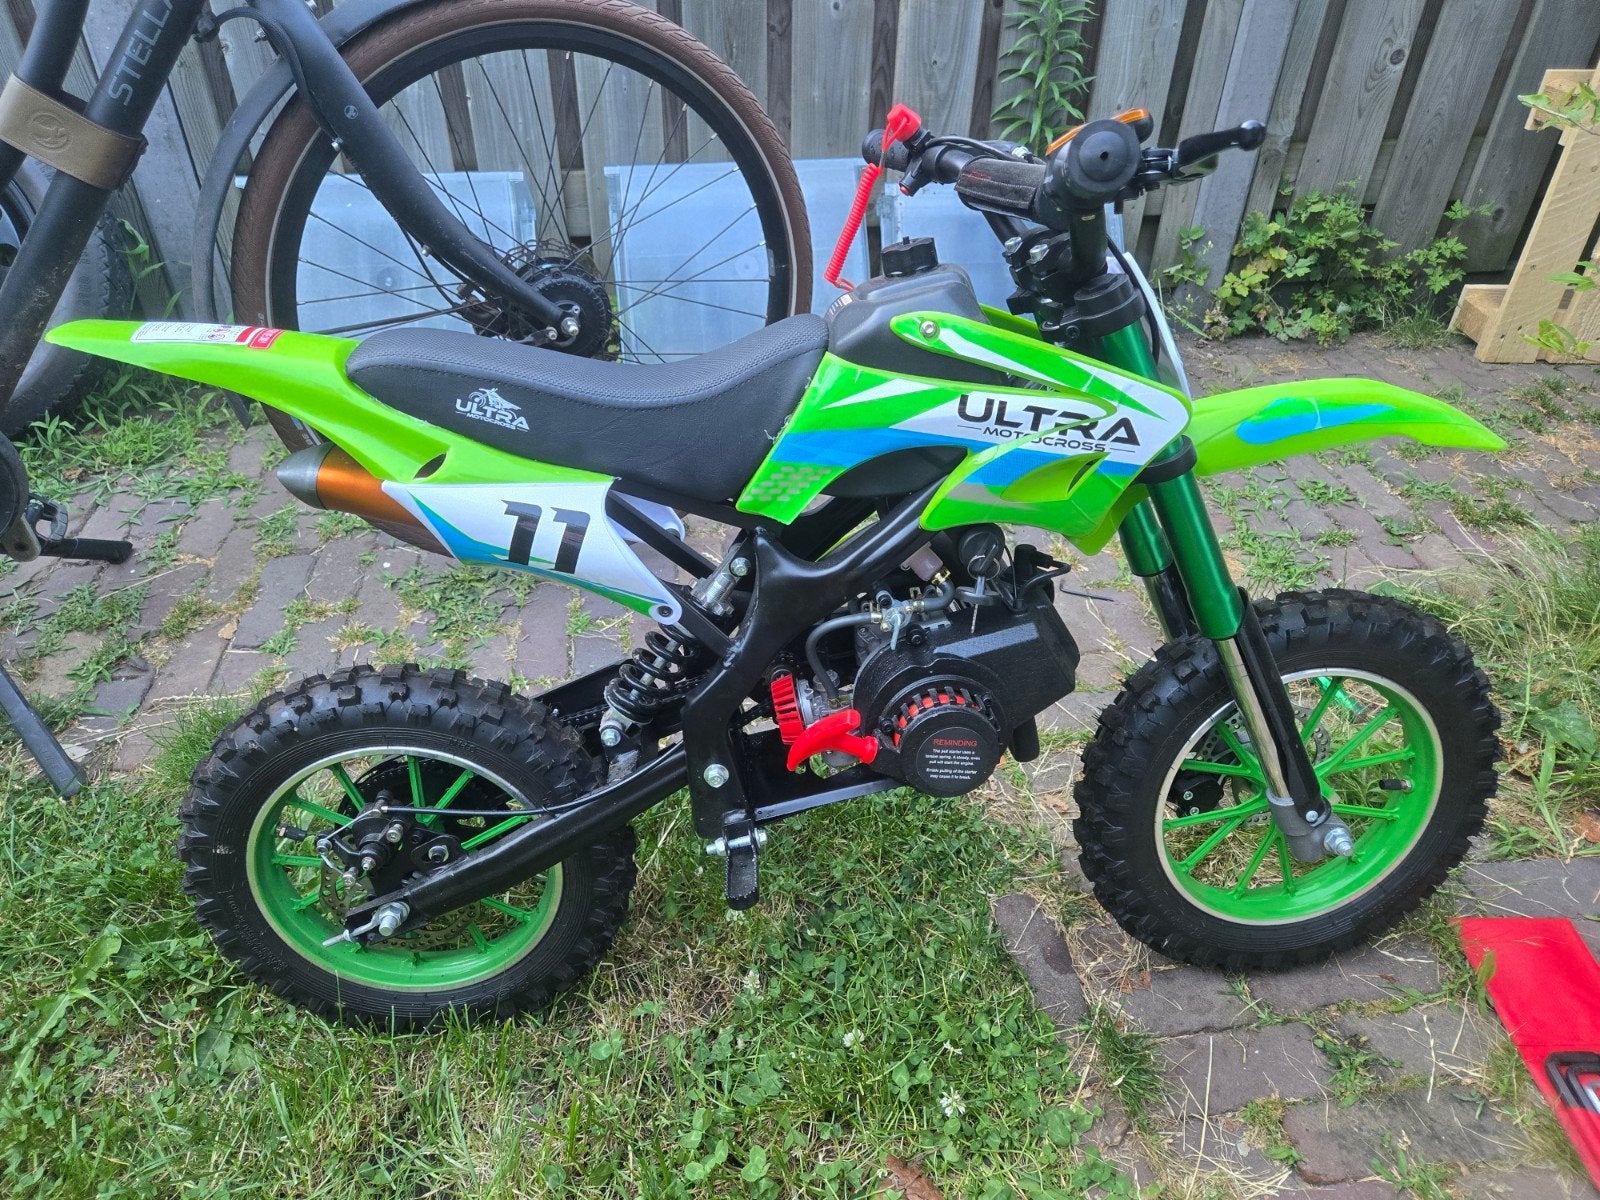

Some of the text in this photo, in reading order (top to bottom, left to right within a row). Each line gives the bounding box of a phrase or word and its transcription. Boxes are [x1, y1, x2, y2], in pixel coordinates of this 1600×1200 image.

[455, 398, 530, 430] ULTRA
[466, 412, 516, 430] MOTOCROSS
[957, 393, 1141, 447] ULTRA
[501, 500, 590, 574] 11
[932, 738, 977, 747] REMINDING
